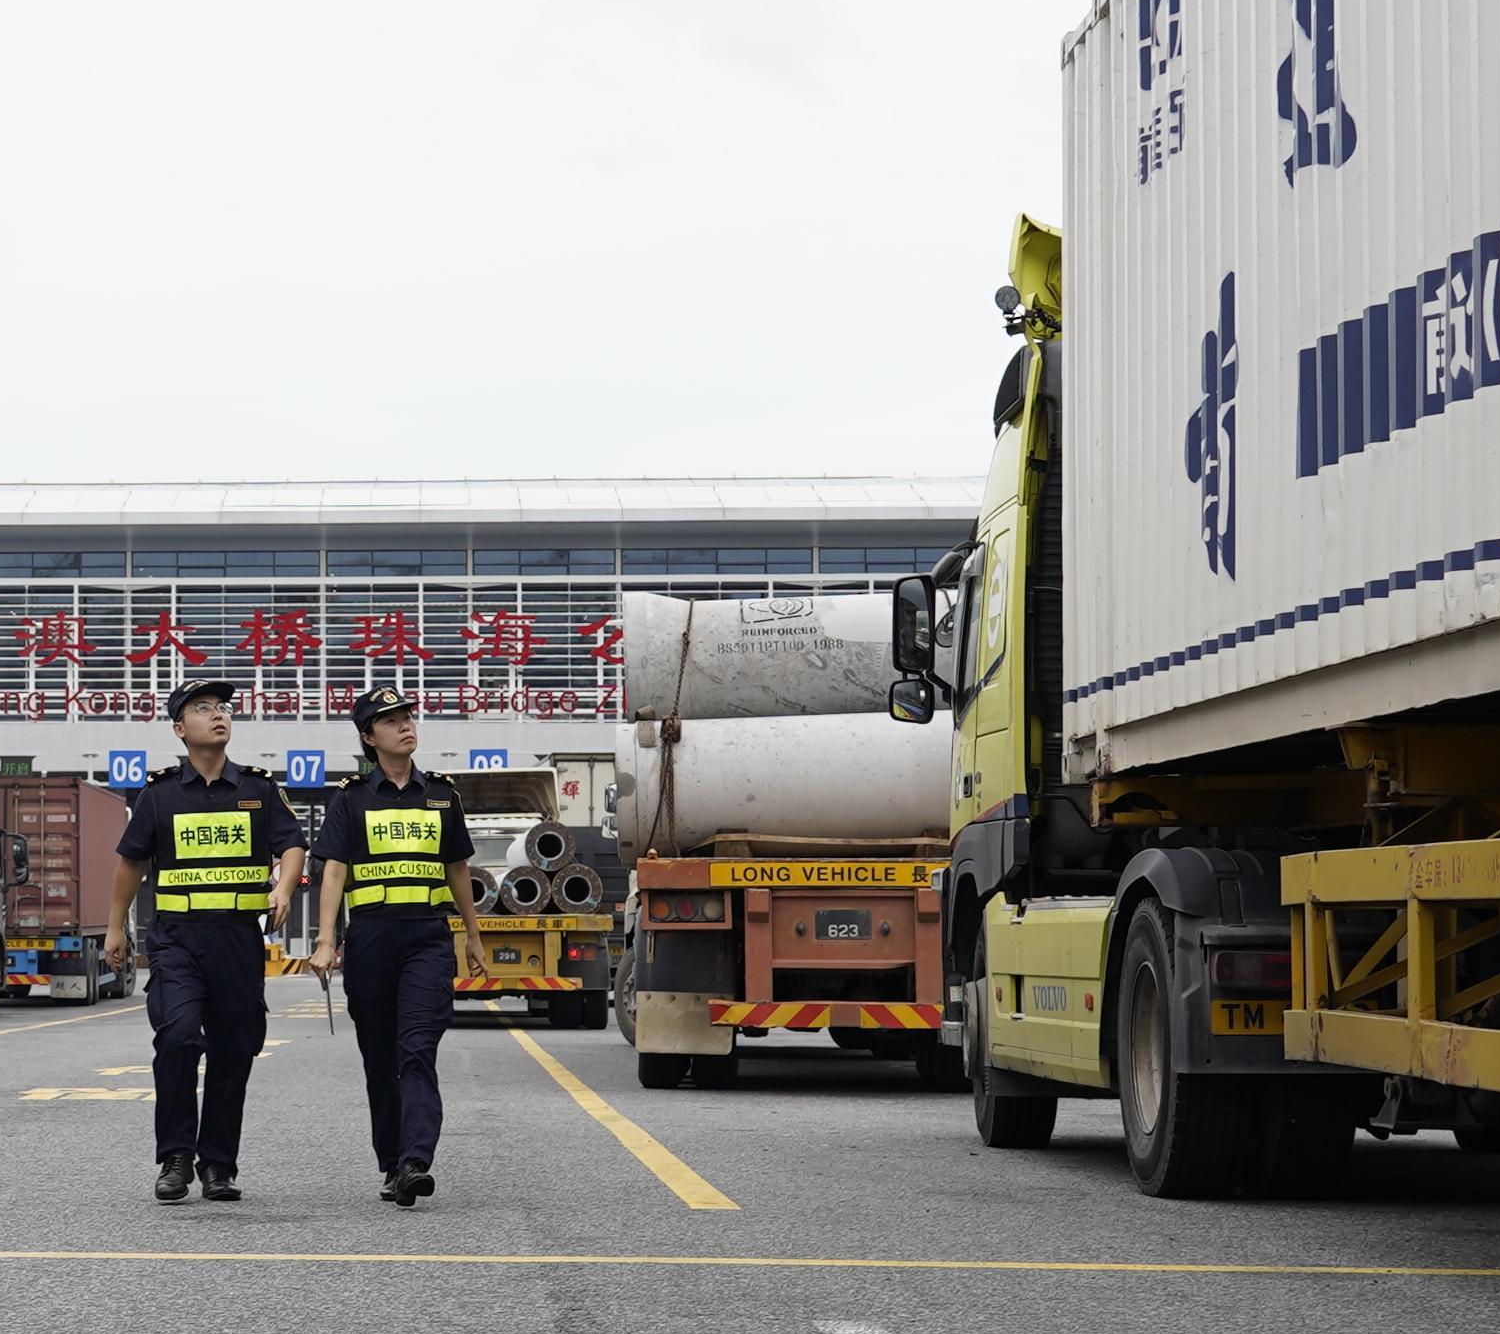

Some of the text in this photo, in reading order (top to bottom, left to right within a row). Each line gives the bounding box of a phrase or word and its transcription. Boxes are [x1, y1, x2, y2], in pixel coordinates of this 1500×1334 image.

[459, 685, 579, 721] Bridge
[112, 756, 143, 782] 06
[291, 756, 321, 782] 07
[180, 824, 247, 846] 中国海关
[372, 821, 437, 841] 中国海关
[168, 869, 262, 884] CHINA CUSTOMS
[360, 863, 442, 877] CHINA CUSTOM
[731, 865, 929, 883] LONG VEHICLE 長
[479, 920, 526, 929] VEHICLE
[828, 924, 859, 938] 623
[1032, 985, 1067, 1012] VOLVO
[1221, 1003, 1264, 1030] TM
